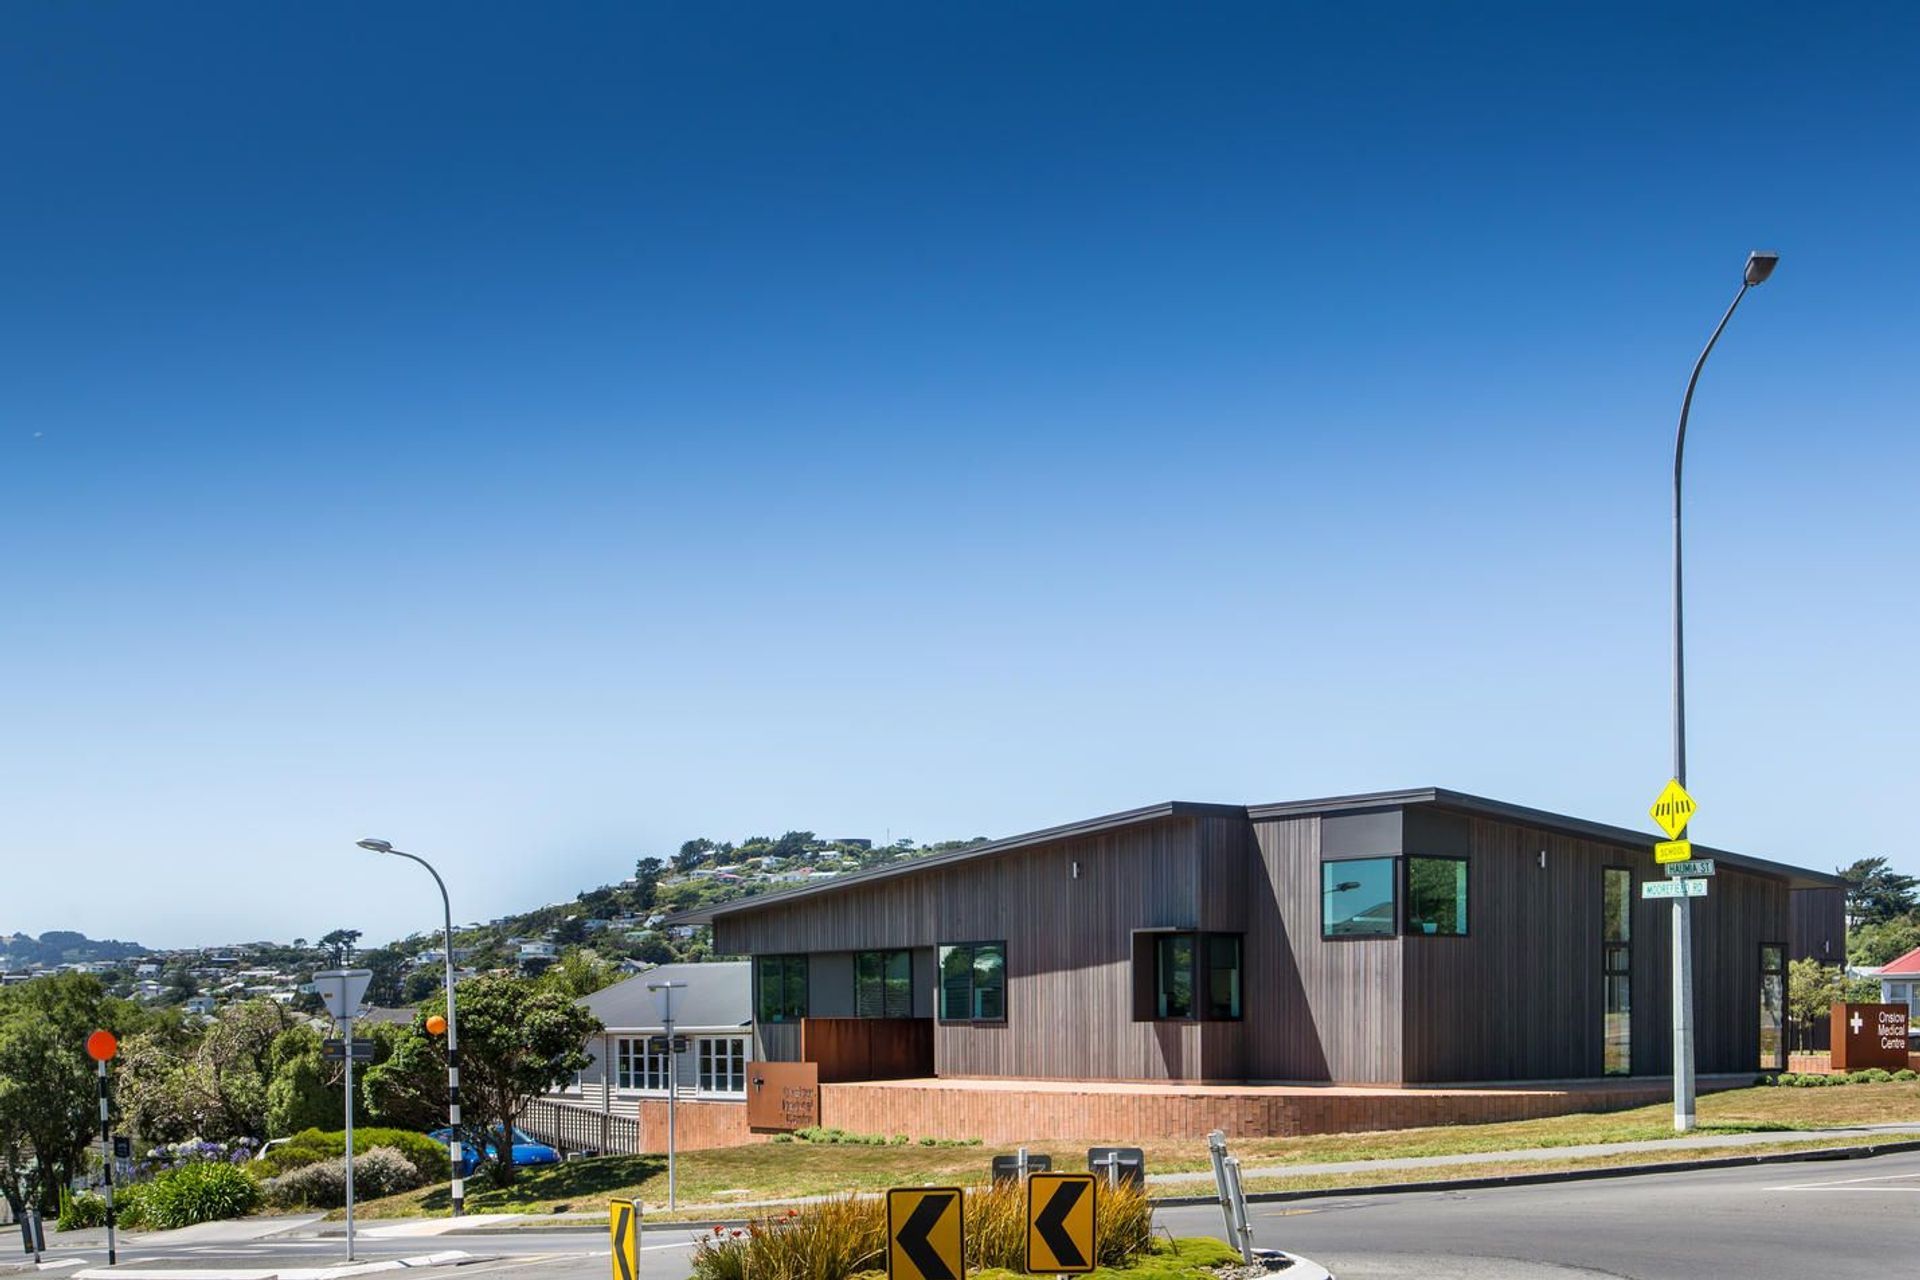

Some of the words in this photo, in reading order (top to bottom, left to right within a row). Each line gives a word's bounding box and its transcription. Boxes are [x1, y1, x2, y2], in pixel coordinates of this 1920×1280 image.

[1659, 846, 1686, 858] SCHOOL
[1700, 862, 1710, 873] ST
[1693, 882, 1703, 893] RD
[1879, 1011, 1905, 1023] Onslow
[1878, 1024, 1905, 1036] Medical
[1881, 1037, 1905, 1049] Centre
